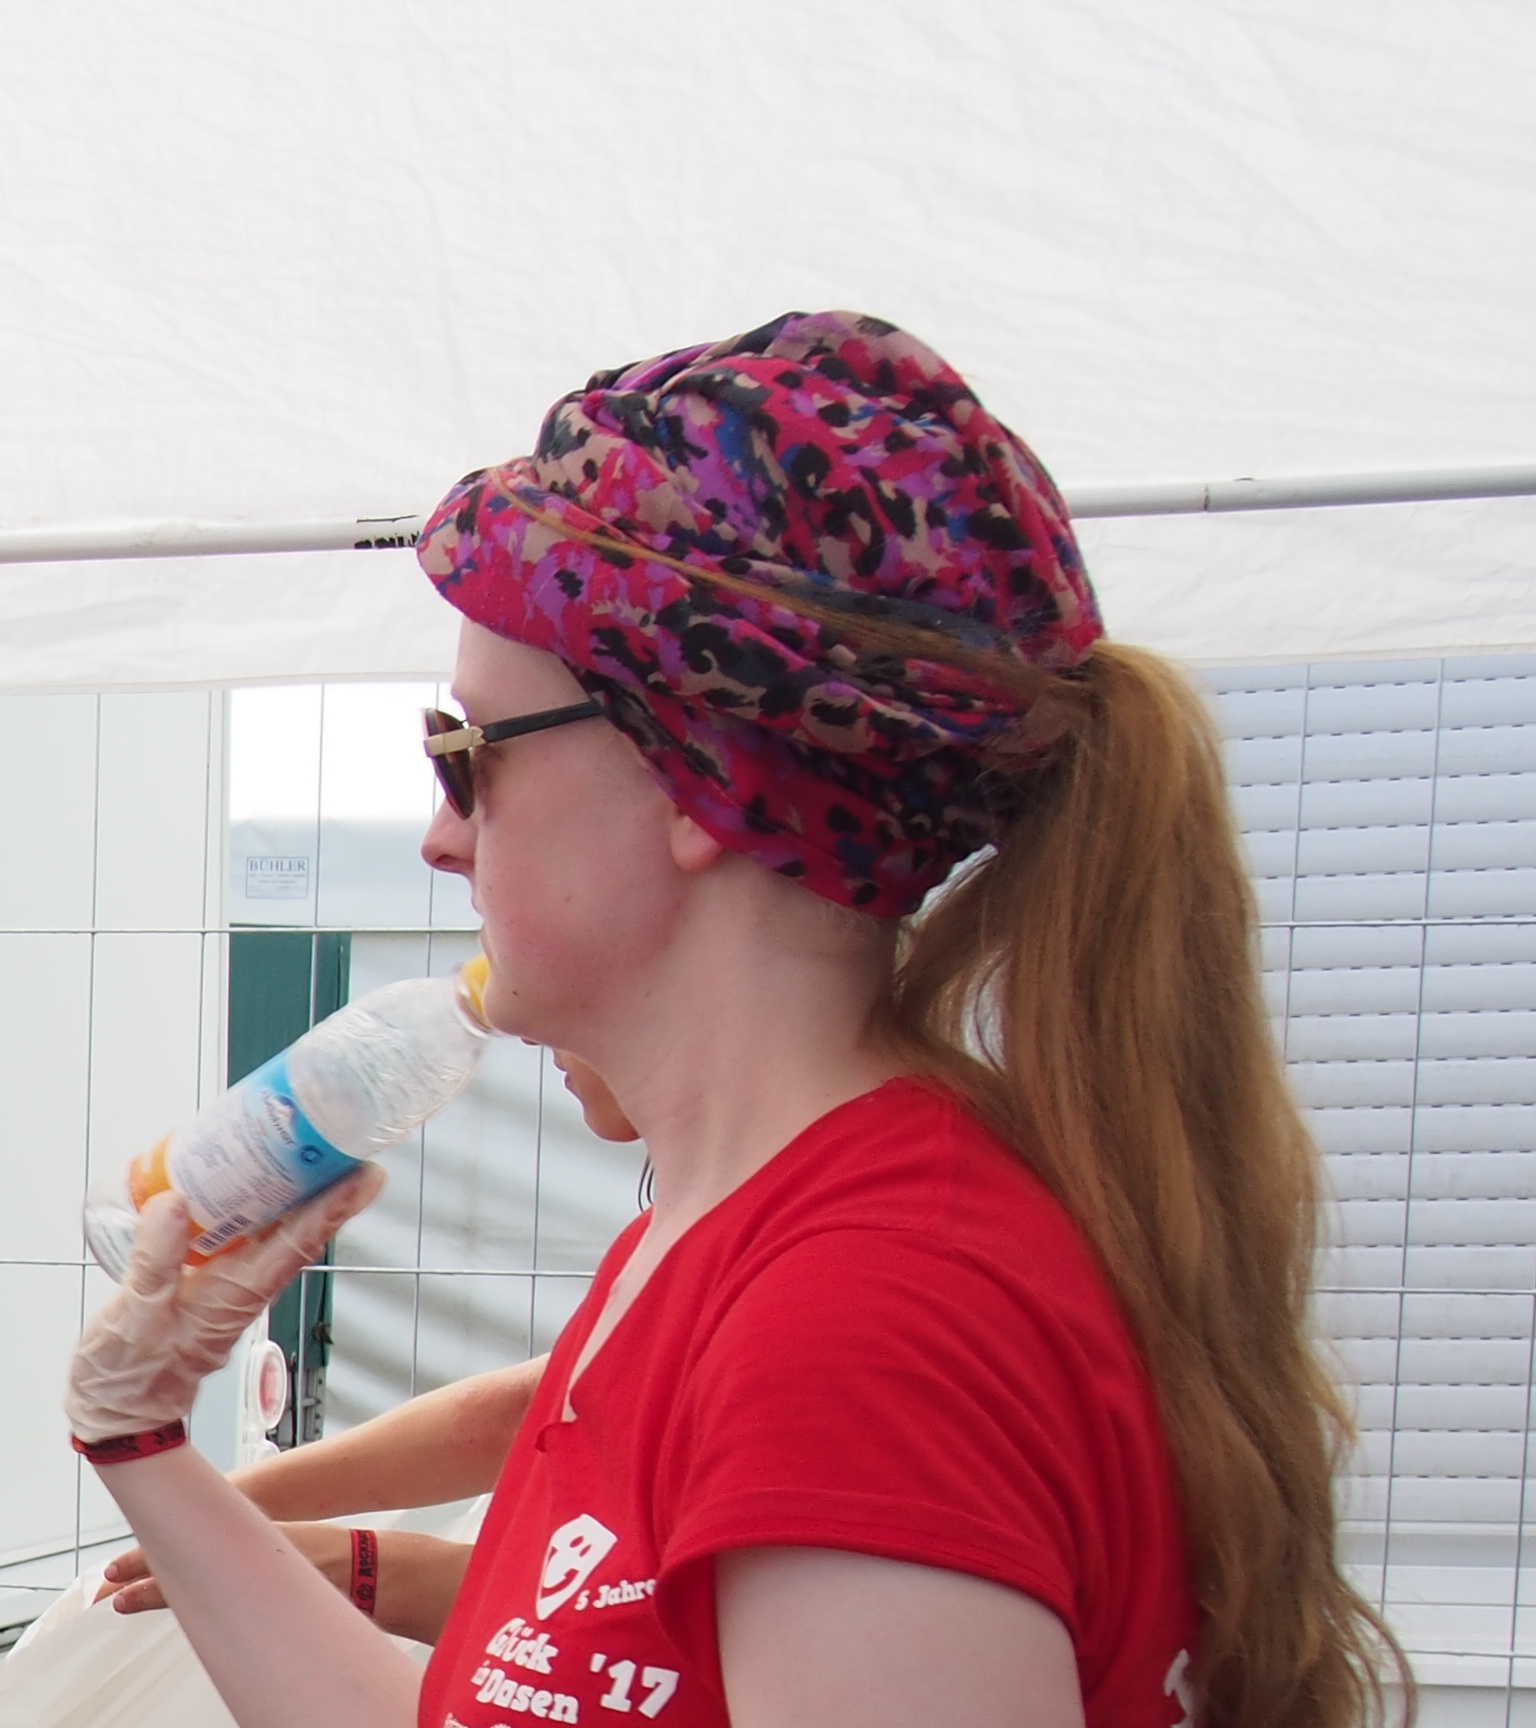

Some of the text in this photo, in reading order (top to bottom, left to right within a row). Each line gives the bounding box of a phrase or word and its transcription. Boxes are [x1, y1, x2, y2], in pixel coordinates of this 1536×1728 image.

[575, 1591, 588, 1612] 5
[485, 1617, 560, 1675] Glück
[475, 1668, 579, 1725] Dasen
